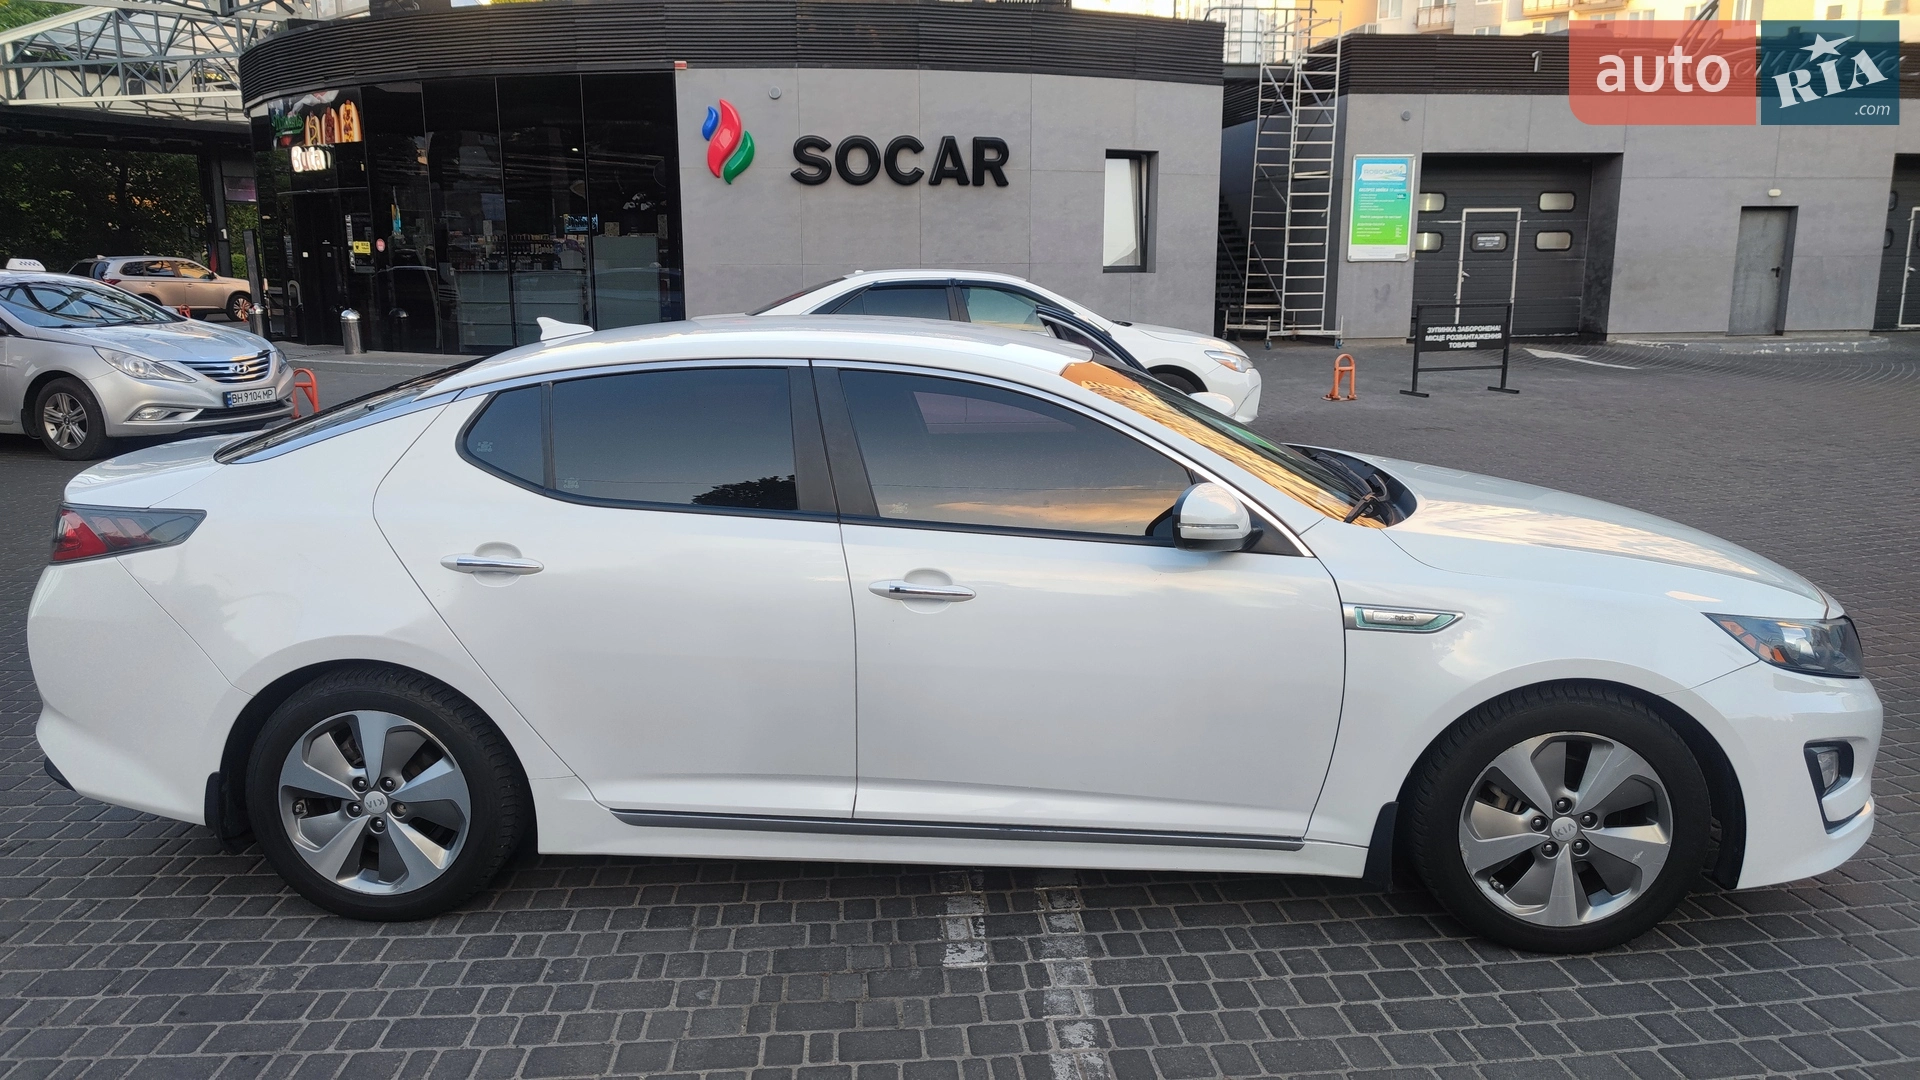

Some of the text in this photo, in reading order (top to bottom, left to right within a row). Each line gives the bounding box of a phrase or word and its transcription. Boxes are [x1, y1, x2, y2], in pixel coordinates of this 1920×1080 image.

[790, 135, 1009, 186] SOCAR
[220, 228, 228, 239] 1
[1425, 333, 1502, 342] МІСЦЕ РОЗВАНТАЖЕННЯ
[232, 389, 273, 403] BH 9104 MP
[366, 798, 385, 808] KIA
[1554, 823, 1575, 837] KIA
